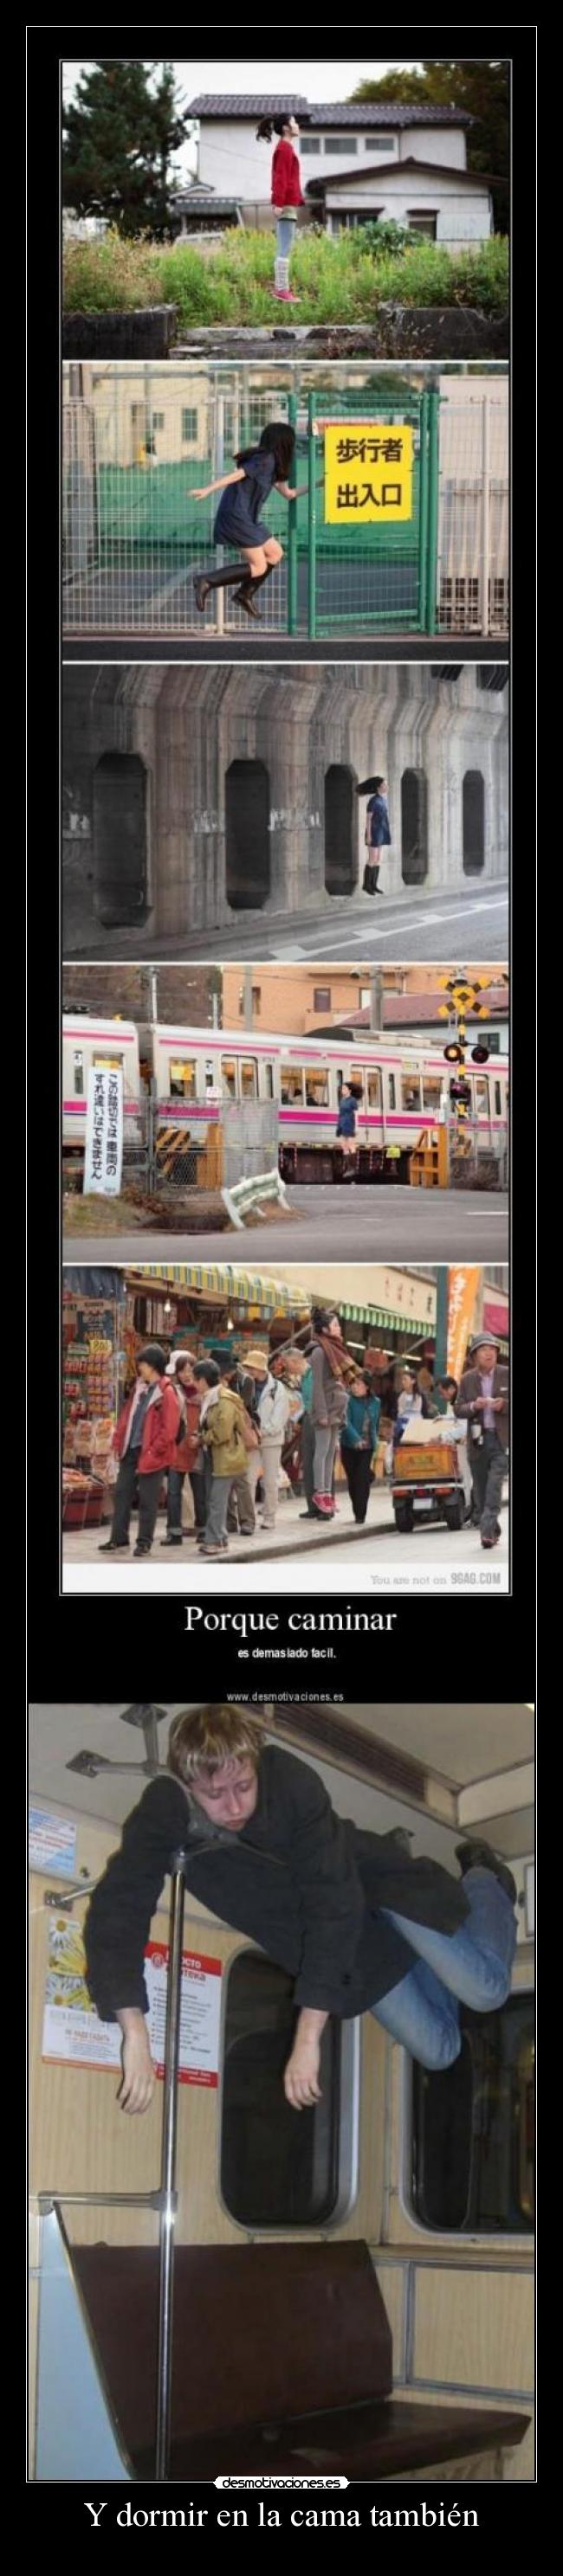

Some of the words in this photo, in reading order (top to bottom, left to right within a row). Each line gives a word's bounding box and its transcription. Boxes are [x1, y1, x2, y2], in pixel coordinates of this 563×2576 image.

[336, 438, 403, 463] 歩行者
[336, 483, 402, 508] 出入口
